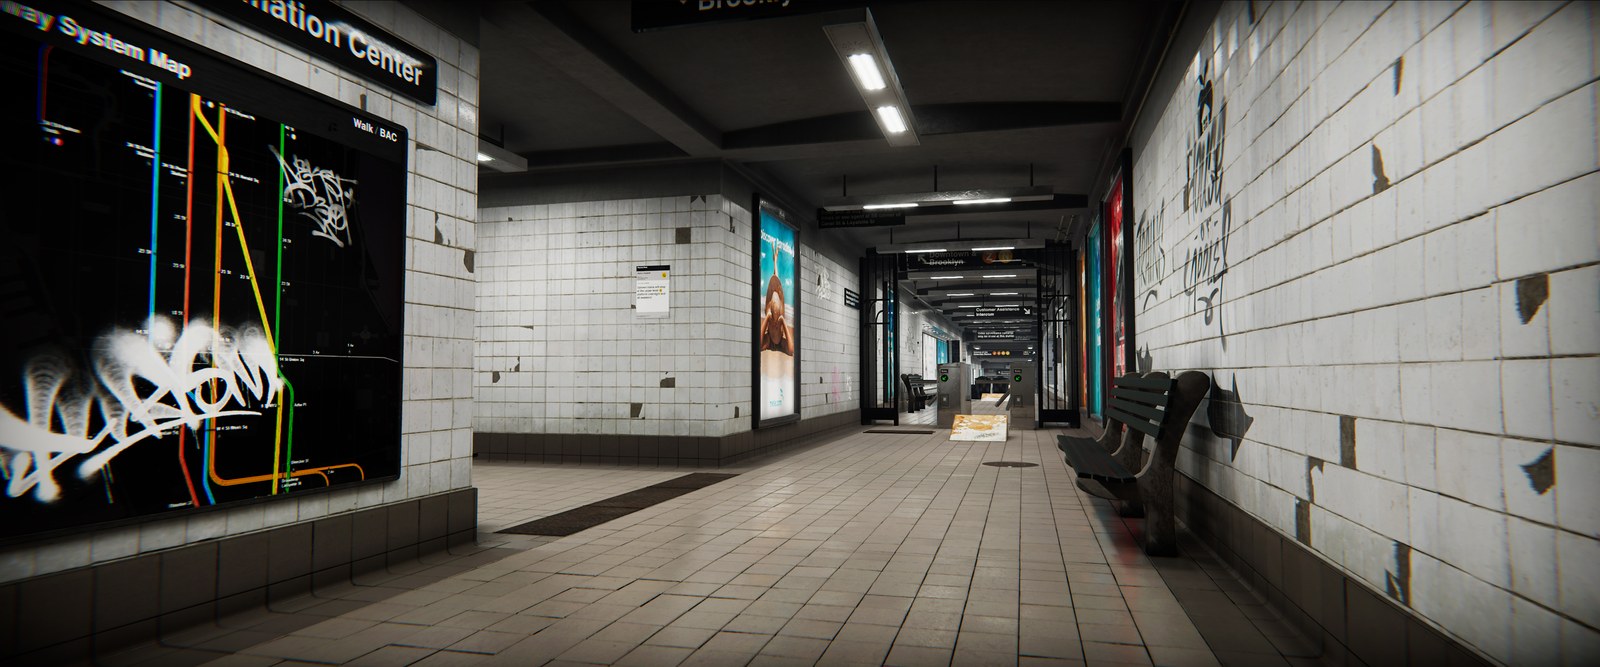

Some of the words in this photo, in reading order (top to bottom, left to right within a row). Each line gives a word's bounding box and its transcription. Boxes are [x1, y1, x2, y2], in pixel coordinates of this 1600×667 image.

[57, 14, 145, 61] System
[149, 48, 192, 80] Map
[348, 30, 423, 85] Center
[353, 117, 373, 134] Walk
[380, 127, 398, 142] BAC
[930, 251, 970, 259] Downtown
[930, 258, 964, 267] Brooklyn
